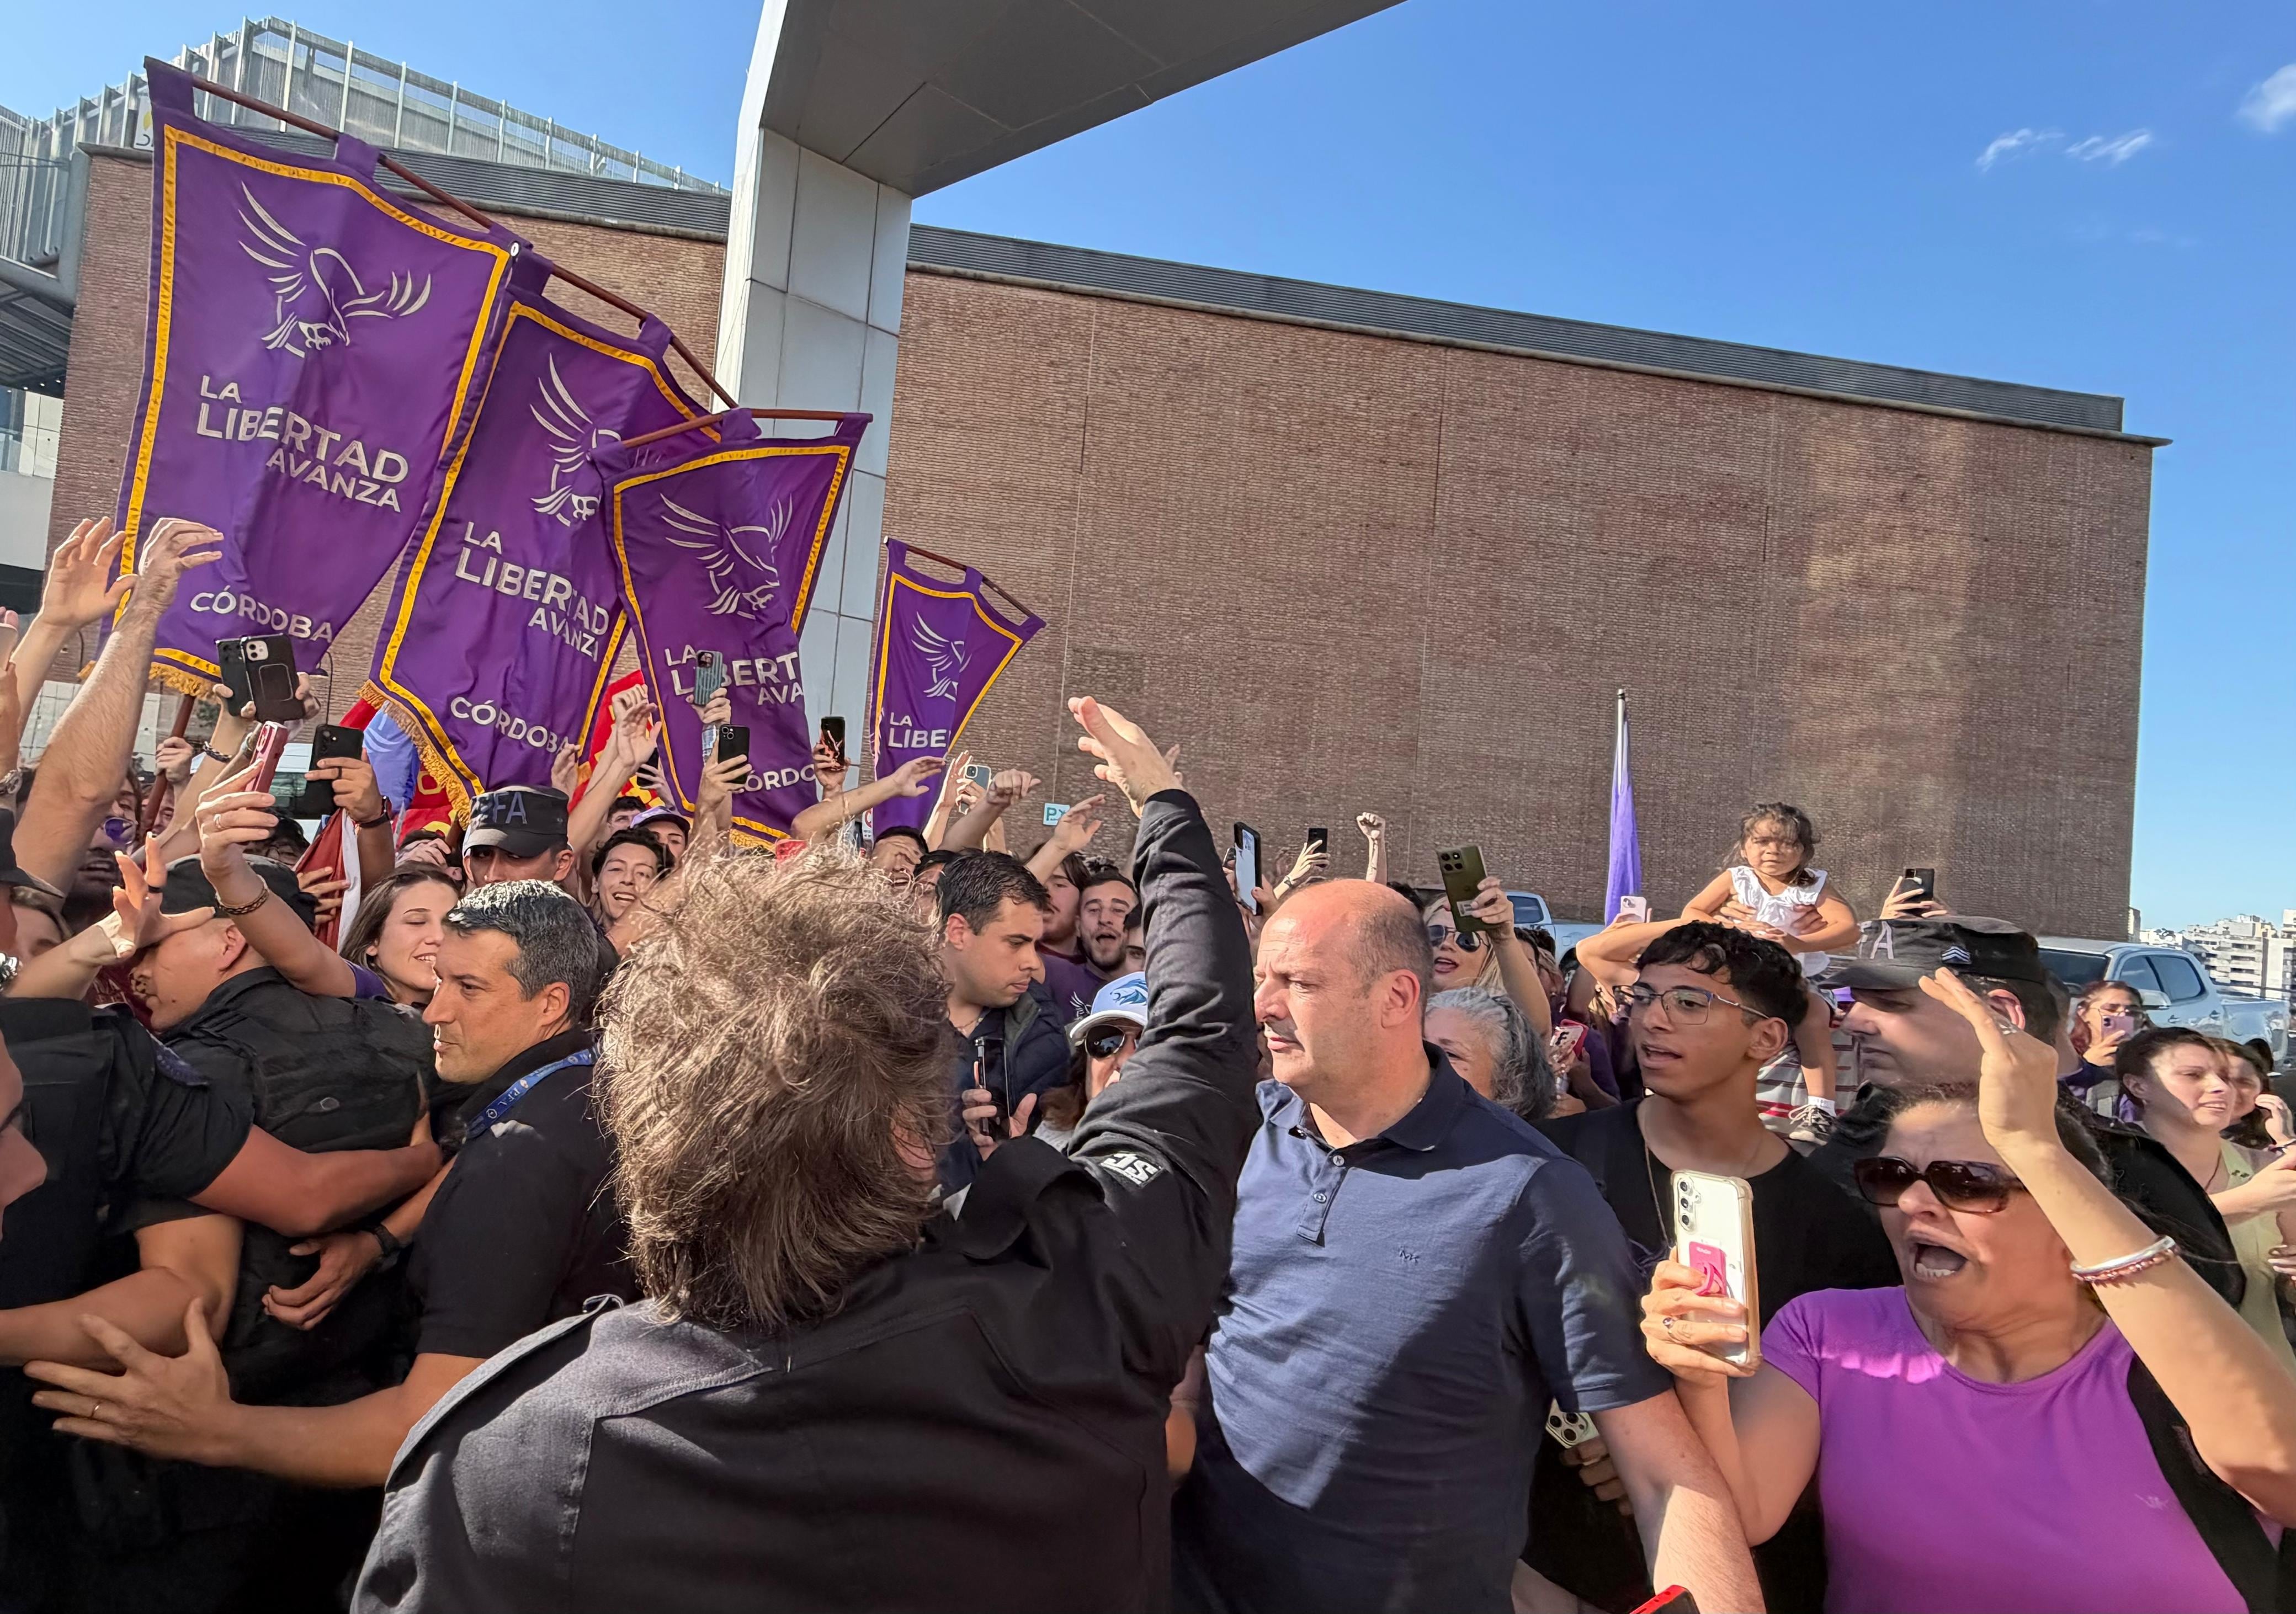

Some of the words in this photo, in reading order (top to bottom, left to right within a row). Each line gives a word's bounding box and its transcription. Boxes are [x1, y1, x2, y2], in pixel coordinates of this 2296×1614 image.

[200, 375, 242, 403] LA
[196, 403, 409, 483] LIBERTAD
[265, 447, 401, 513] AVANZA
[464, 521, 502, 555] LA
[190, 585, 333, 643] CÓRDOBA
[665, 644, 697, 666] LA
[671, 652, 799, 696] LBERT
[757, 681, 804, 706] AVA
[890, 712, 912, 727] LA
[887, 727, 952, 748] LIBE
